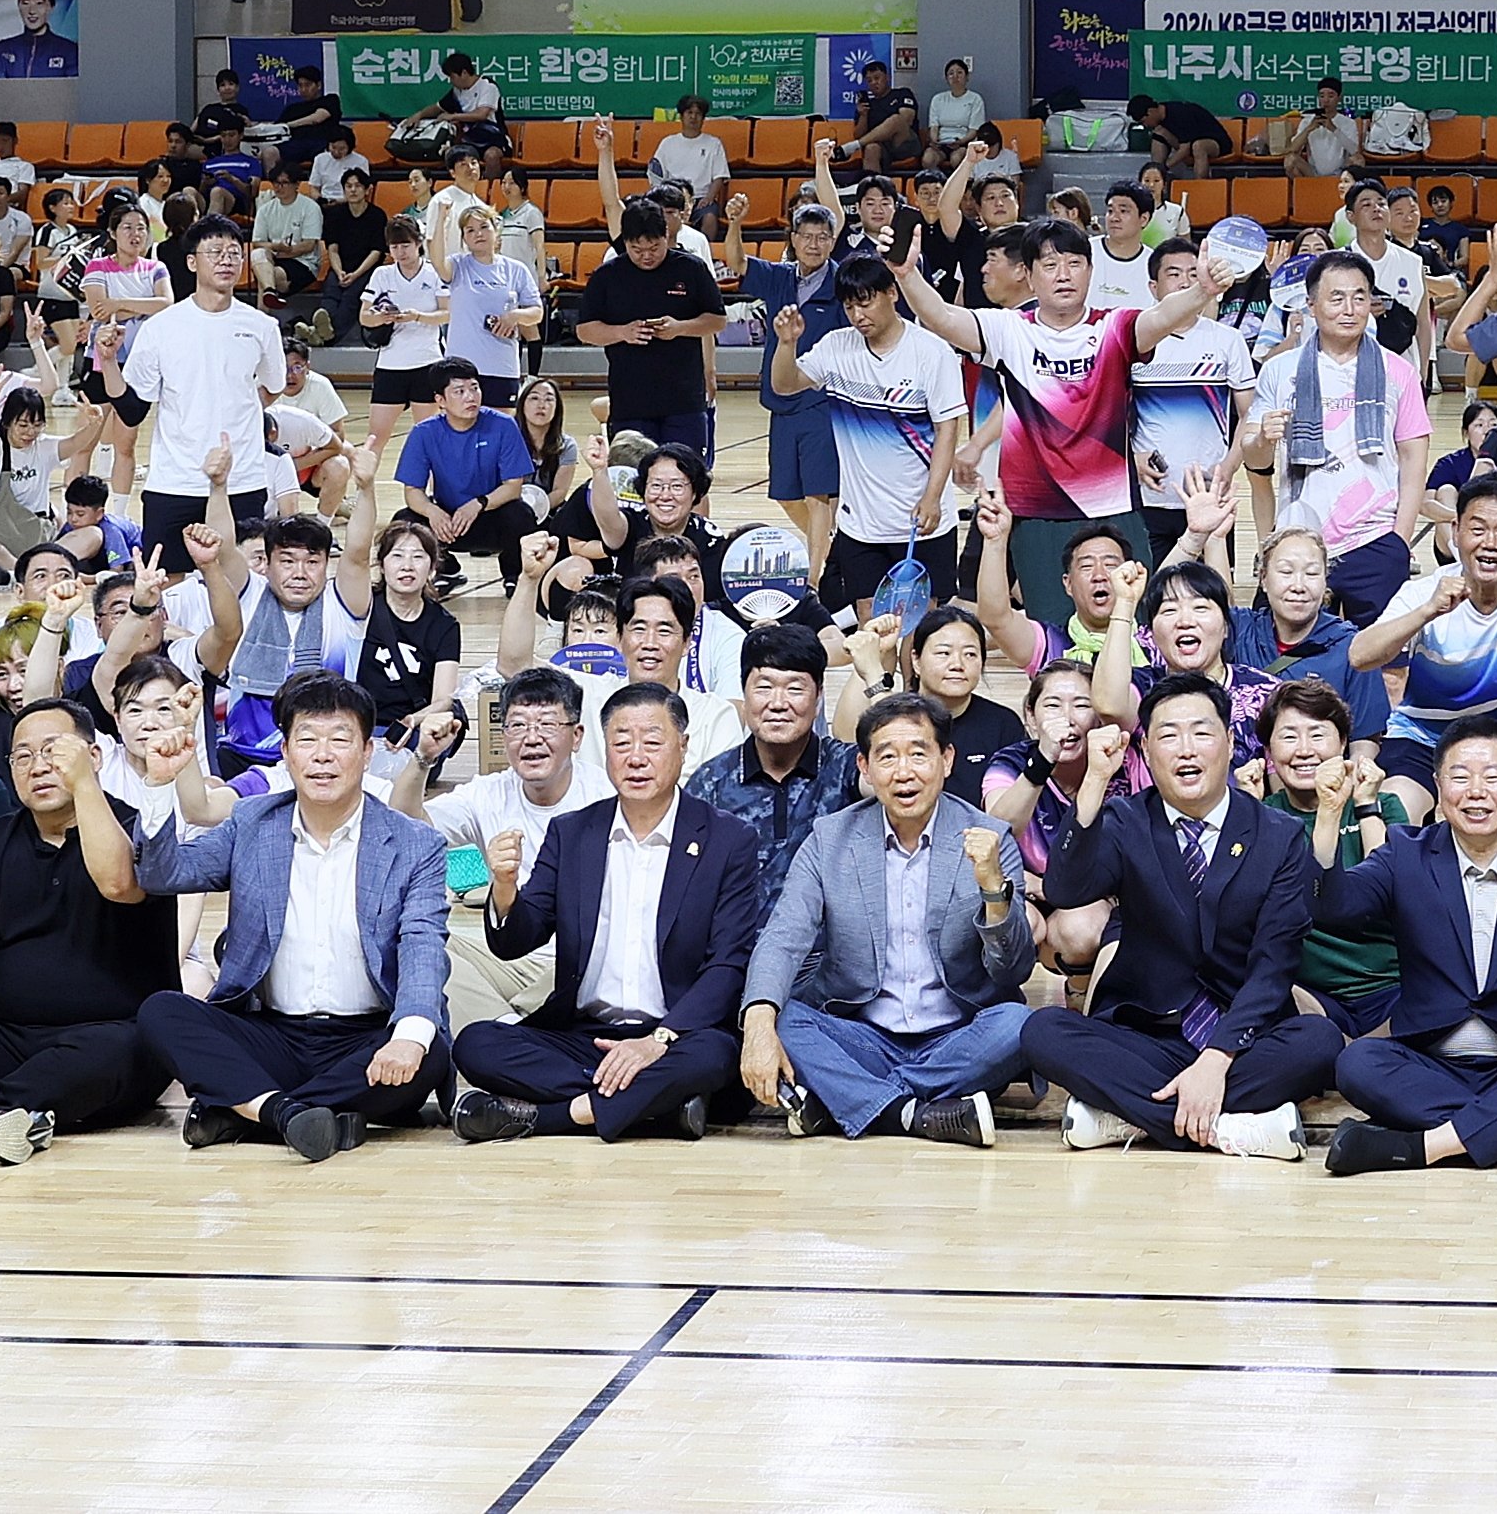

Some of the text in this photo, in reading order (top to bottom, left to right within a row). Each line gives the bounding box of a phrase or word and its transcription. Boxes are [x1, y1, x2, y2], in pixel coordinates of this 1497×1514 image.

[538, 45, 687, 84] 환영합니다
[1144, 44, 1492, 83] 나주시선수단 환영합니다
